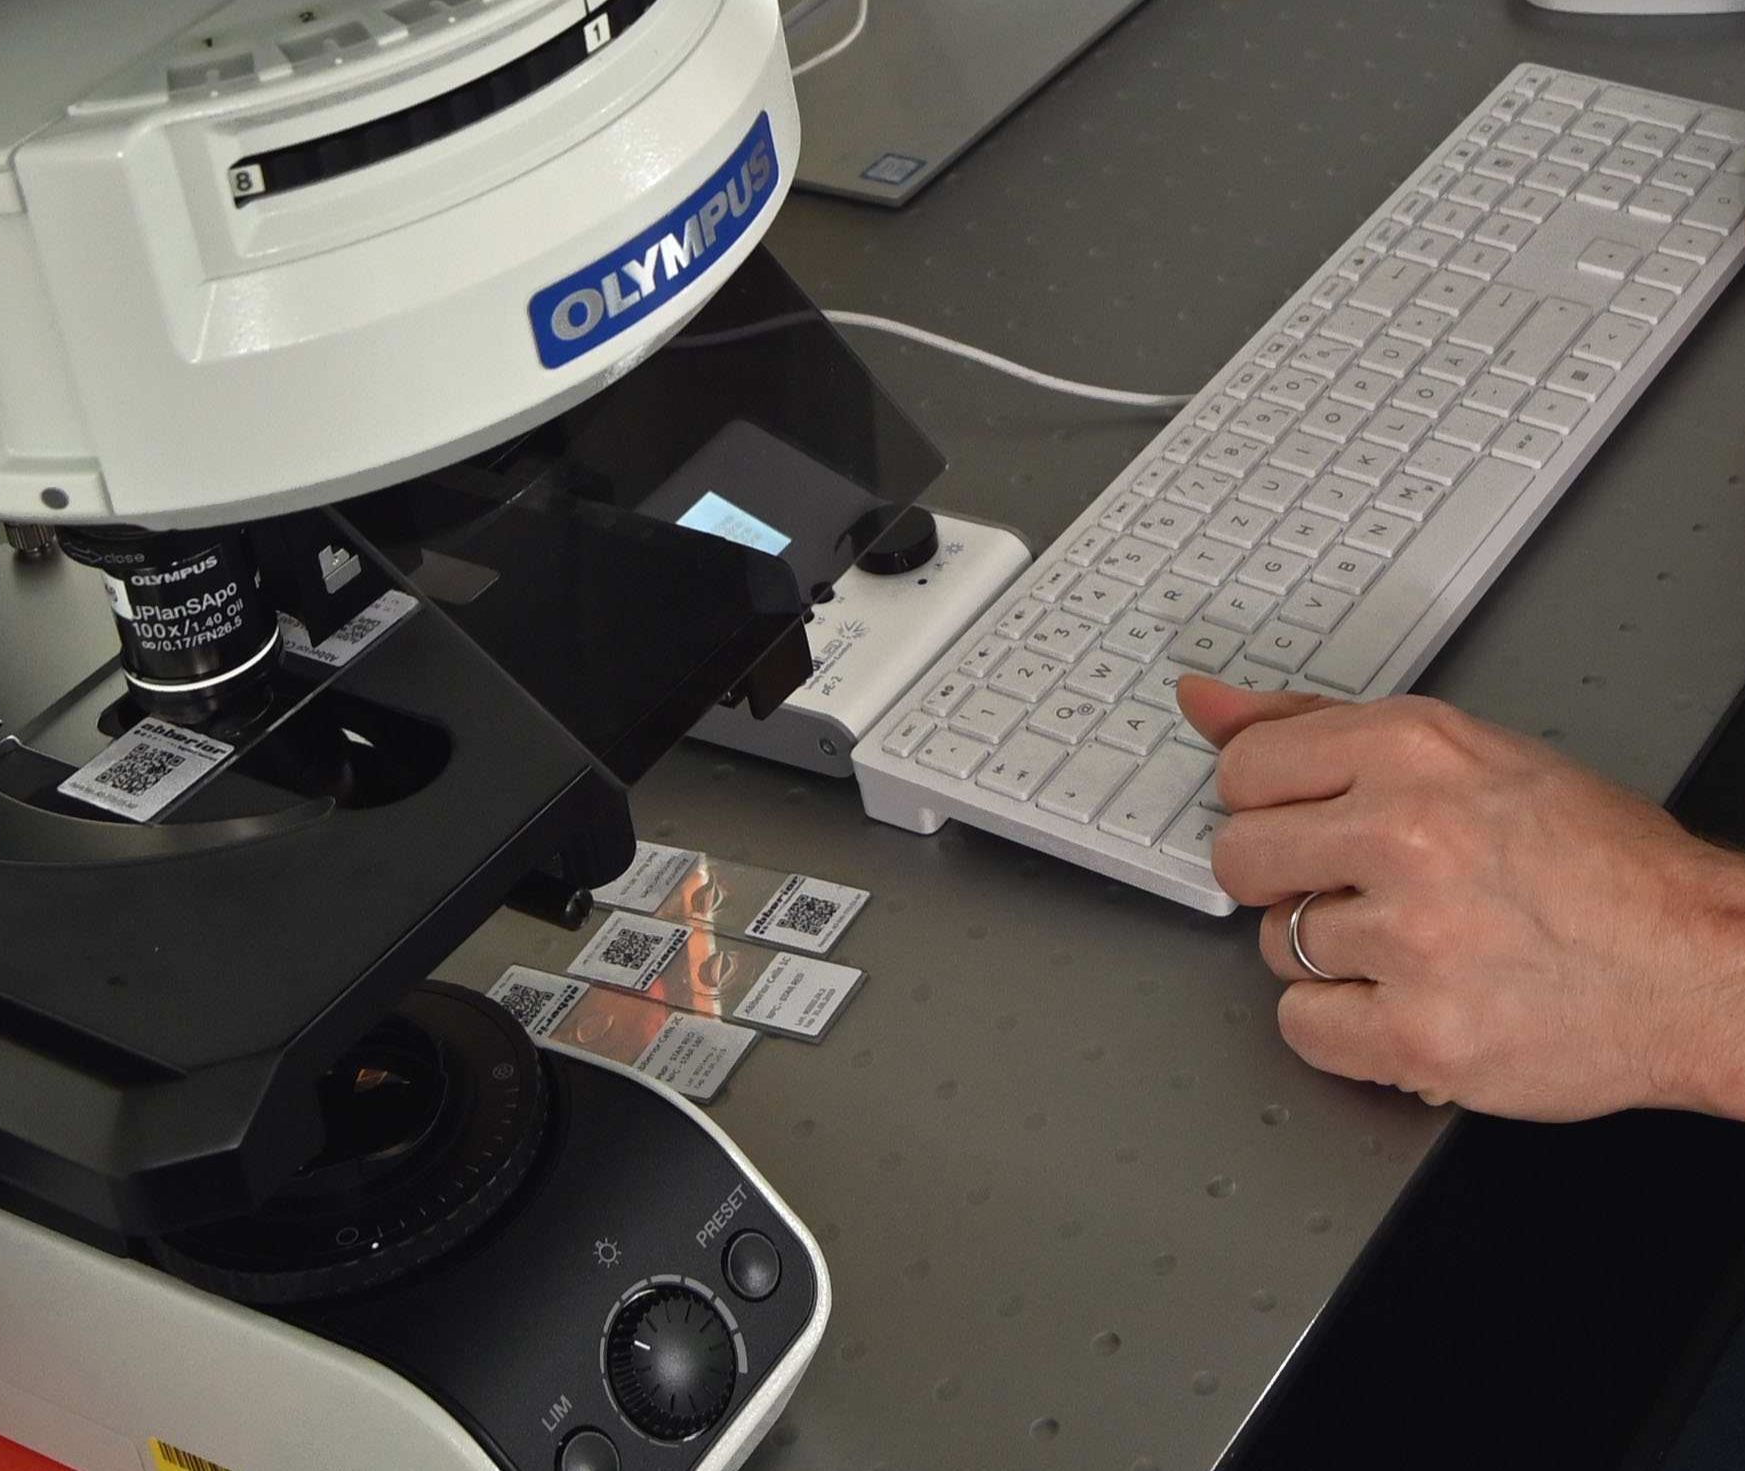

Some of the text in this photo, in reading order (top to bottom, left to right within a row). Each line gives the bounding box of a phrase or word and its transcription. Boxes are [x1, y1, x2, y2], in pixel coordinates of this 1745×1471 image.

[592, 23, 602, 42] 1
[235, 171, 254, 192] 8
[551, 140, 772, 342] OLYMPUS
[104, 552, 145, 565] close
[130, 555, 219, 587] OLYMPUS
[226, 598, 245, 618] Oil
[140, 722, 227, 756] abberior
[695, 1183, 749, 1249] PRESET
[541, 1394, 574, 1433] LIM
